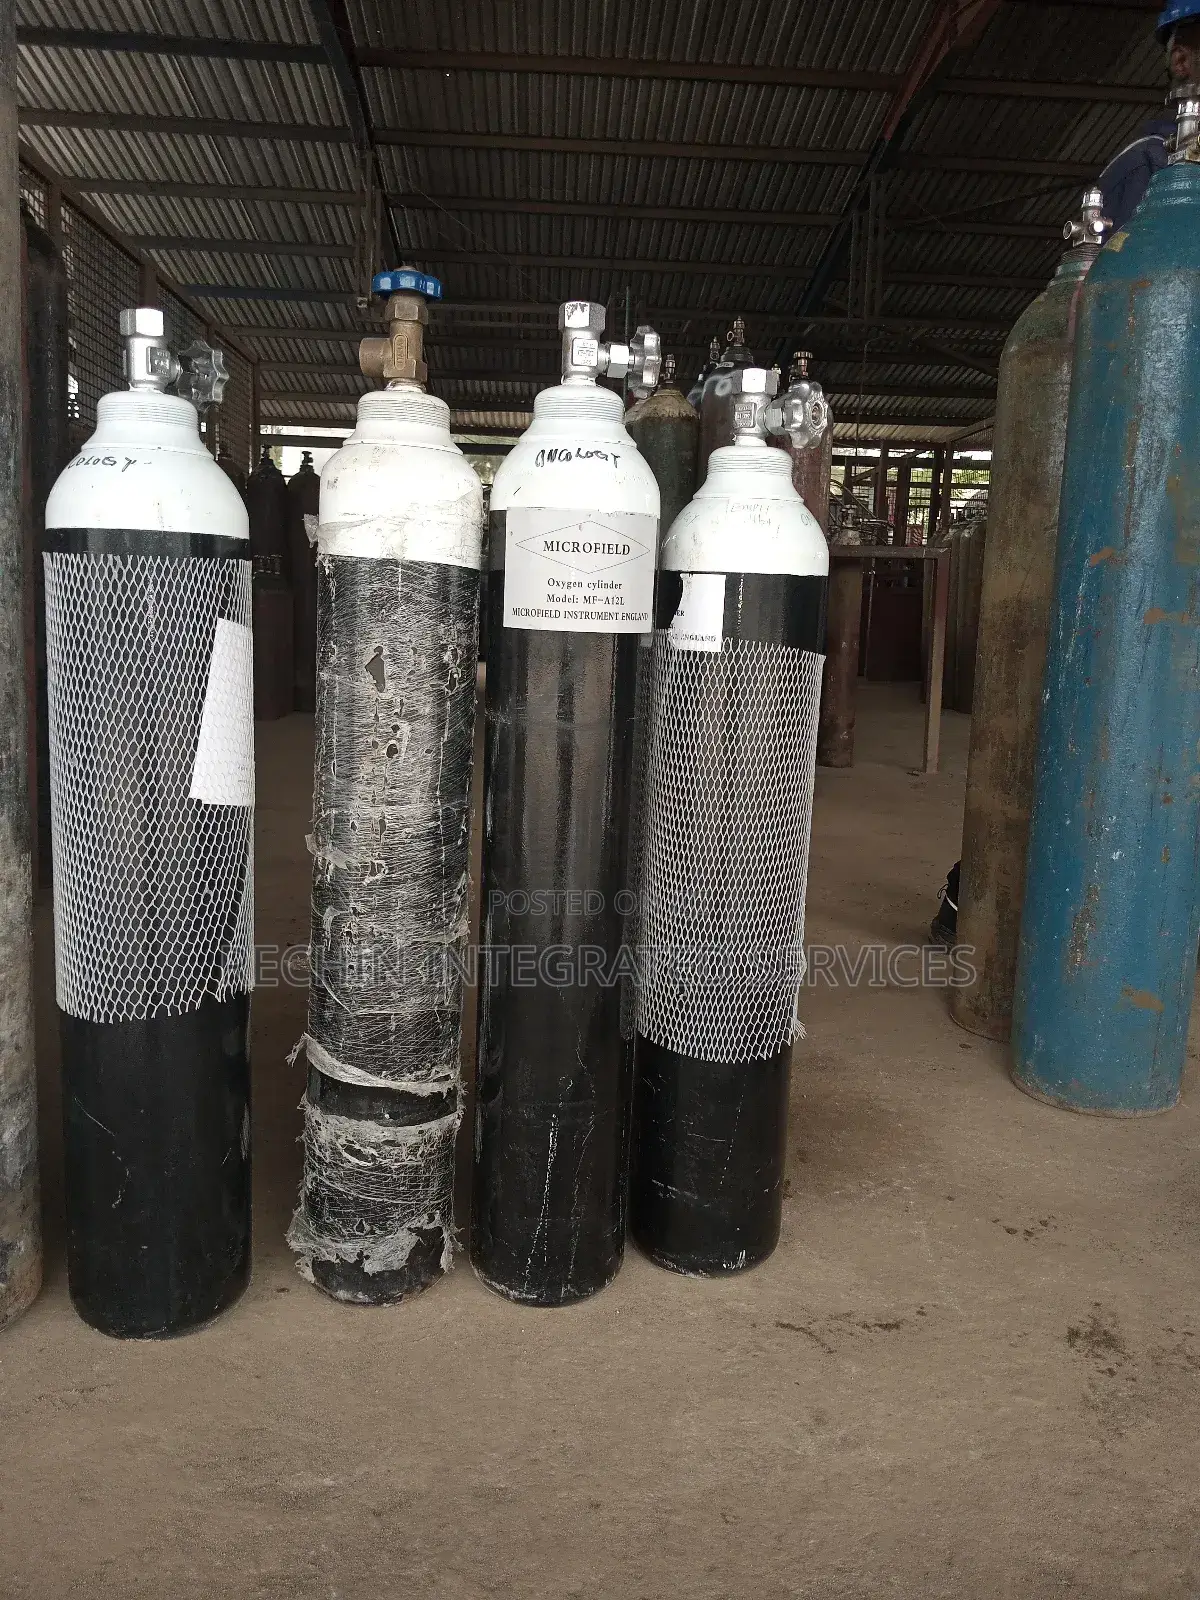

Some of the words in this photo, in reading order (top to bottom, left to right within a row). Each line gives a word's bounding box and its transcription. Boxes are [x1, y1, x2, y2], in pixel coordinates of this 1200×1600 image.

[543, 540, 631, 556] MICROFIELD
[547, 577, 583, 590] Oxygen
[587, 579, 623, 591] cylinder
[546, 593, 579, 604] Model:
[512, 607, 561, 619] MICROFIELD
[563, 610, 620, 621] INSTRUMENT
[621, 612, 649, 621] ENGLAND
